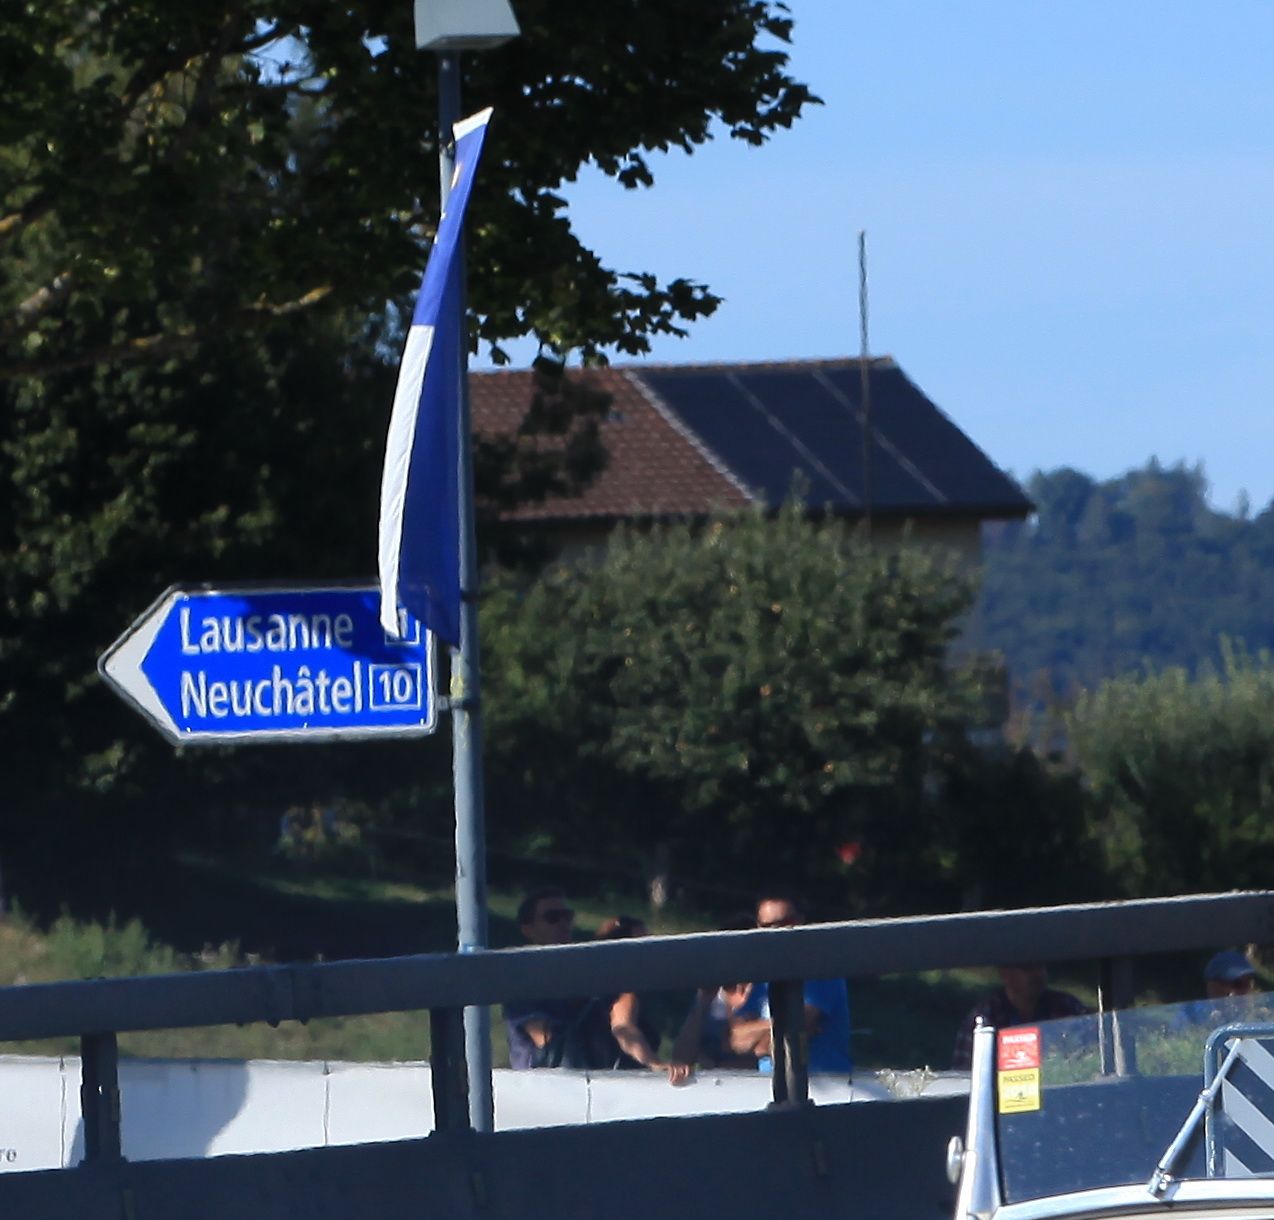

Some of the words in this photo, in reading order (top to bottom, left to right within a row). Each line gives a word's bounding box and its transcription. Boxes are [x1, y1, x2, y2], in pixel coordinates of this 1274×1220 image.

[180, 607, 354, 655] Lausanne
[180, 660, 363, 719] Neuchâtel
[379, 669, 413, 703] 10
